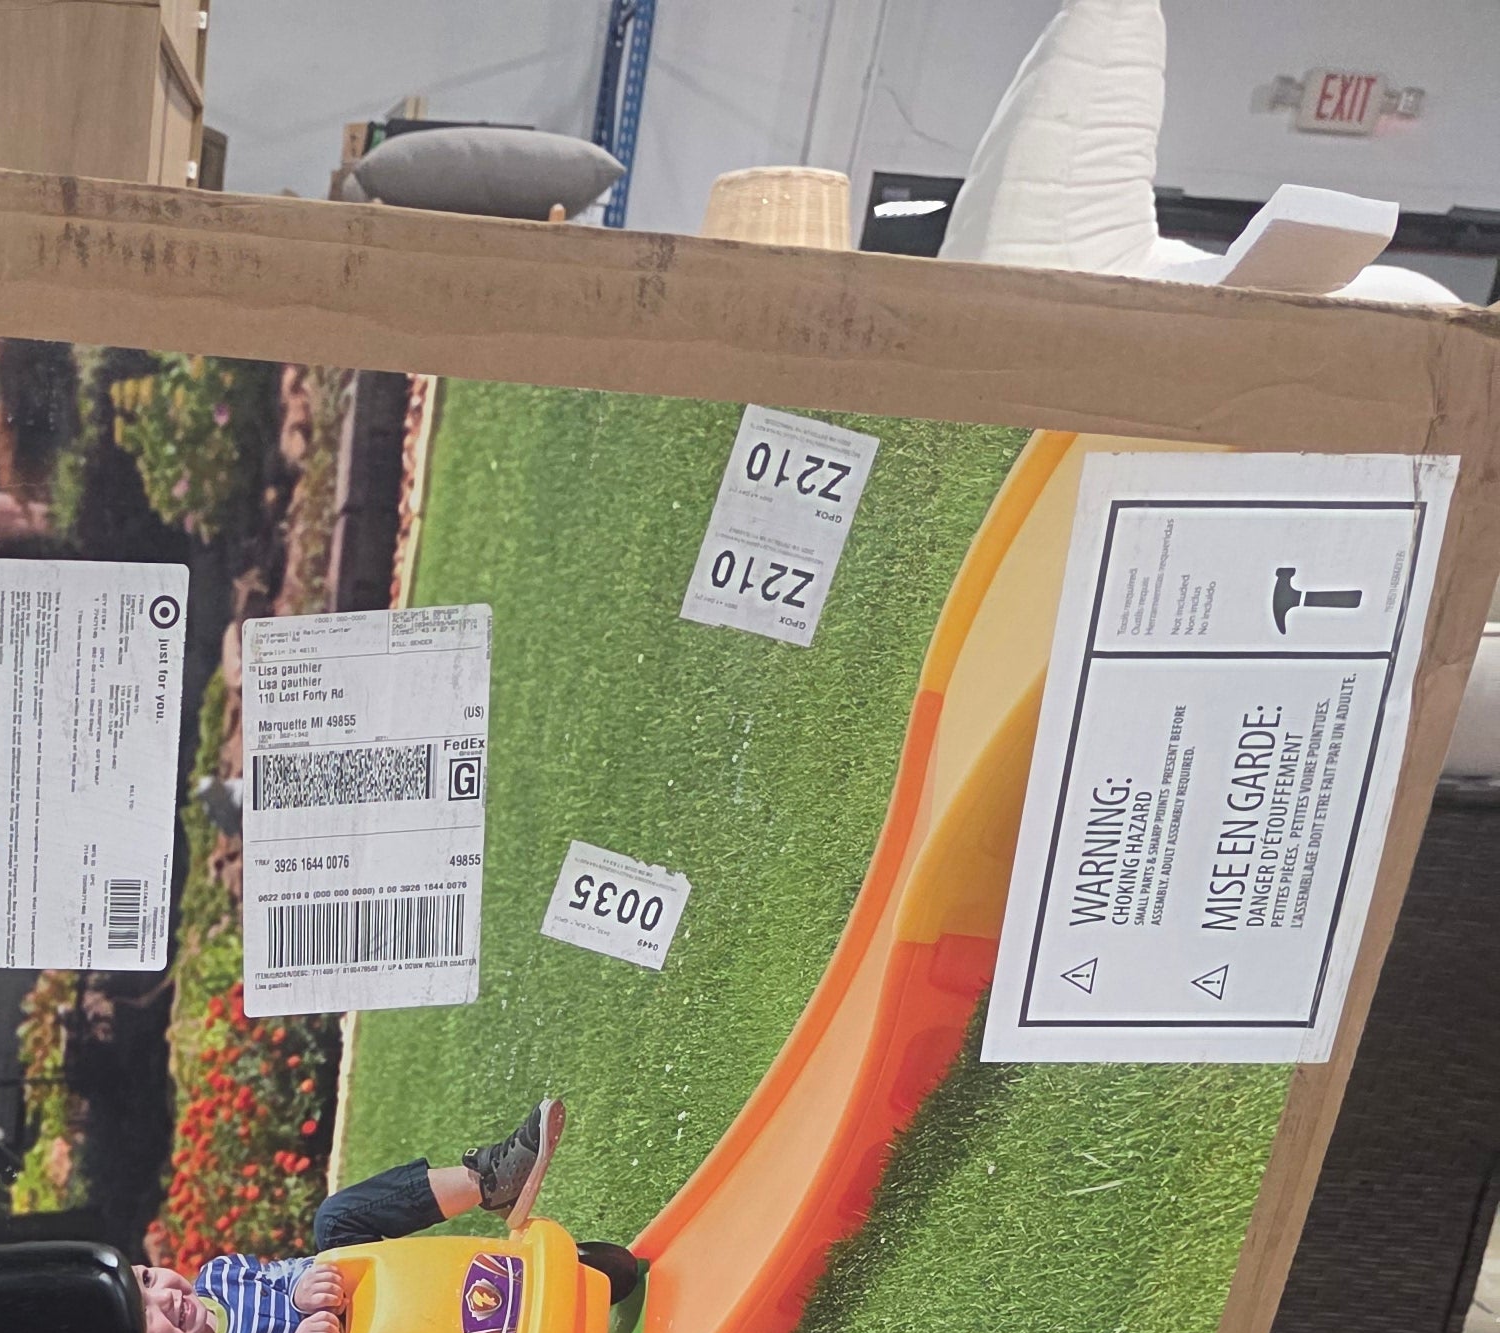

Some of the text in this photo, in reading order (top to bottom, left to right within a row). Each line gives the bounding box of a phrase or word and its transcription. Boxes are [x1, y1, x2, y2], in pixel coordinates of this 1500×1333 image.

[1315, 73, 1378, 122] EXIT
[746, 442, 851, 502] Z210
[815, 509, 842, 523] GPOX
[1159, 519, 1174, 571] requeridas
[711, 549, 815, 608] Z210
[1170, 574, 1190, 635] Not included
[1184, 586, 1201, 635] Non inclus
[1198, 581, 1216, 635] No incluido
[779, 616, 806, 630] GPOX
[155, 639, 169, 724] just for you.
[258, 665, 277, 676] Lisa
[281, 663, 322, 676] gauthier
[258, 676, 322, 690] Lisa gauthier
[259, 689, 344, 704] 110 Lost Forty Rd
[463, 706, 484, 719] (US)
[259, 715, 356, 732] Marquette MI 49855
[1170, 705, 1186, 741] BEFORE
[444, 738, 486, 751] FedEx
[454, 762, 476, 796] G
[1162, 744, 1179, 784] PRESENT
[1154, 789, 1170, 823] POINTS
[1201, 705, 1283, 930] MISE EN GARDE:
[1271, 698, 1330, 927] PETITES PIÈCES. PETITES VOIRE POINTUES.
[1291, 673, 1357, 928] L'ASSEMBLAGE DOIT ETRE FAIT PAR UN ADULTE.
[1148, 825, 1163, 855] SHARP
[1151, 746, 1195, 925] ASSEMBLY. ADULT ASSEMBLY REQUIRED.
[1246, 732, 1303, 926] DANGER D'ÉTOUFFEMENT
[274, 857, 297, 873] 3926
[301, 856, 323, 871] 1644
[327, 855, 349, 869] 0076
[450, 854, 481, 867] 49855
[1069, 776, 1132, 926] WARNING:
[1111, 791, 1152, 925] CHOKING HAZARD
[400, 884, 421, 893] 3926
[424, 882, 444, 892] 1644
[447, 881, 467, 890] 0076
[1141, 866, 1155, 894] PARTS
[569, 875, 663, 931] 0035
[1134, 897, 1150, 925] SMALL
[637, 939, 658, 951] 0449
